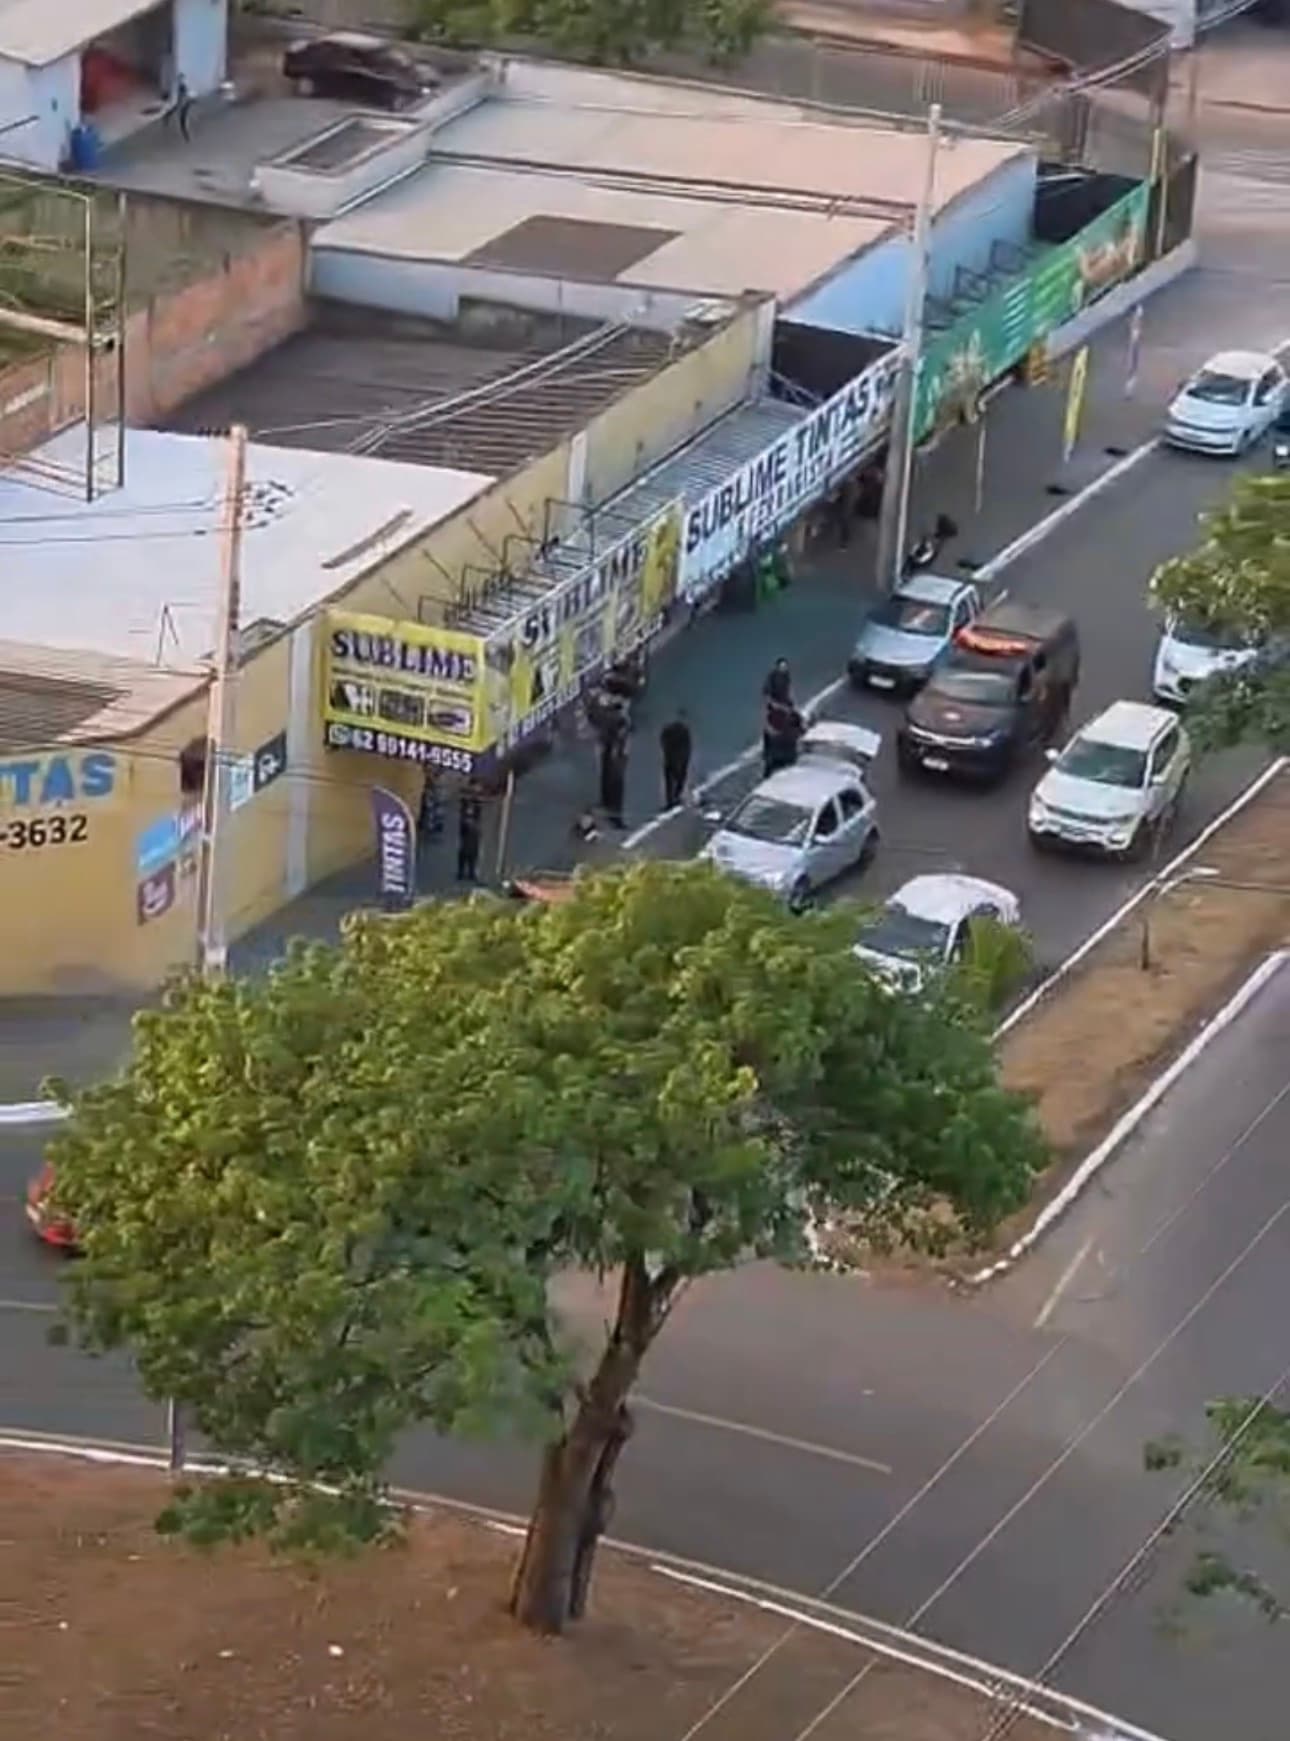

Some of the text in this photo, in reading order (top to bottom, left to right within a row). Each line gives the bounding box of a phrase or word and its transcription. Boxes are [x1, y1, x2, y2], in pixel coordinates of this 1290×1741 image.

[686, 441, 788, 554] SUBLIME
[796, 375, 870, 466] TINTAS
[332, 630, 475, 682] SUBLIME
[381, 812, 406, 893] TINTAS
